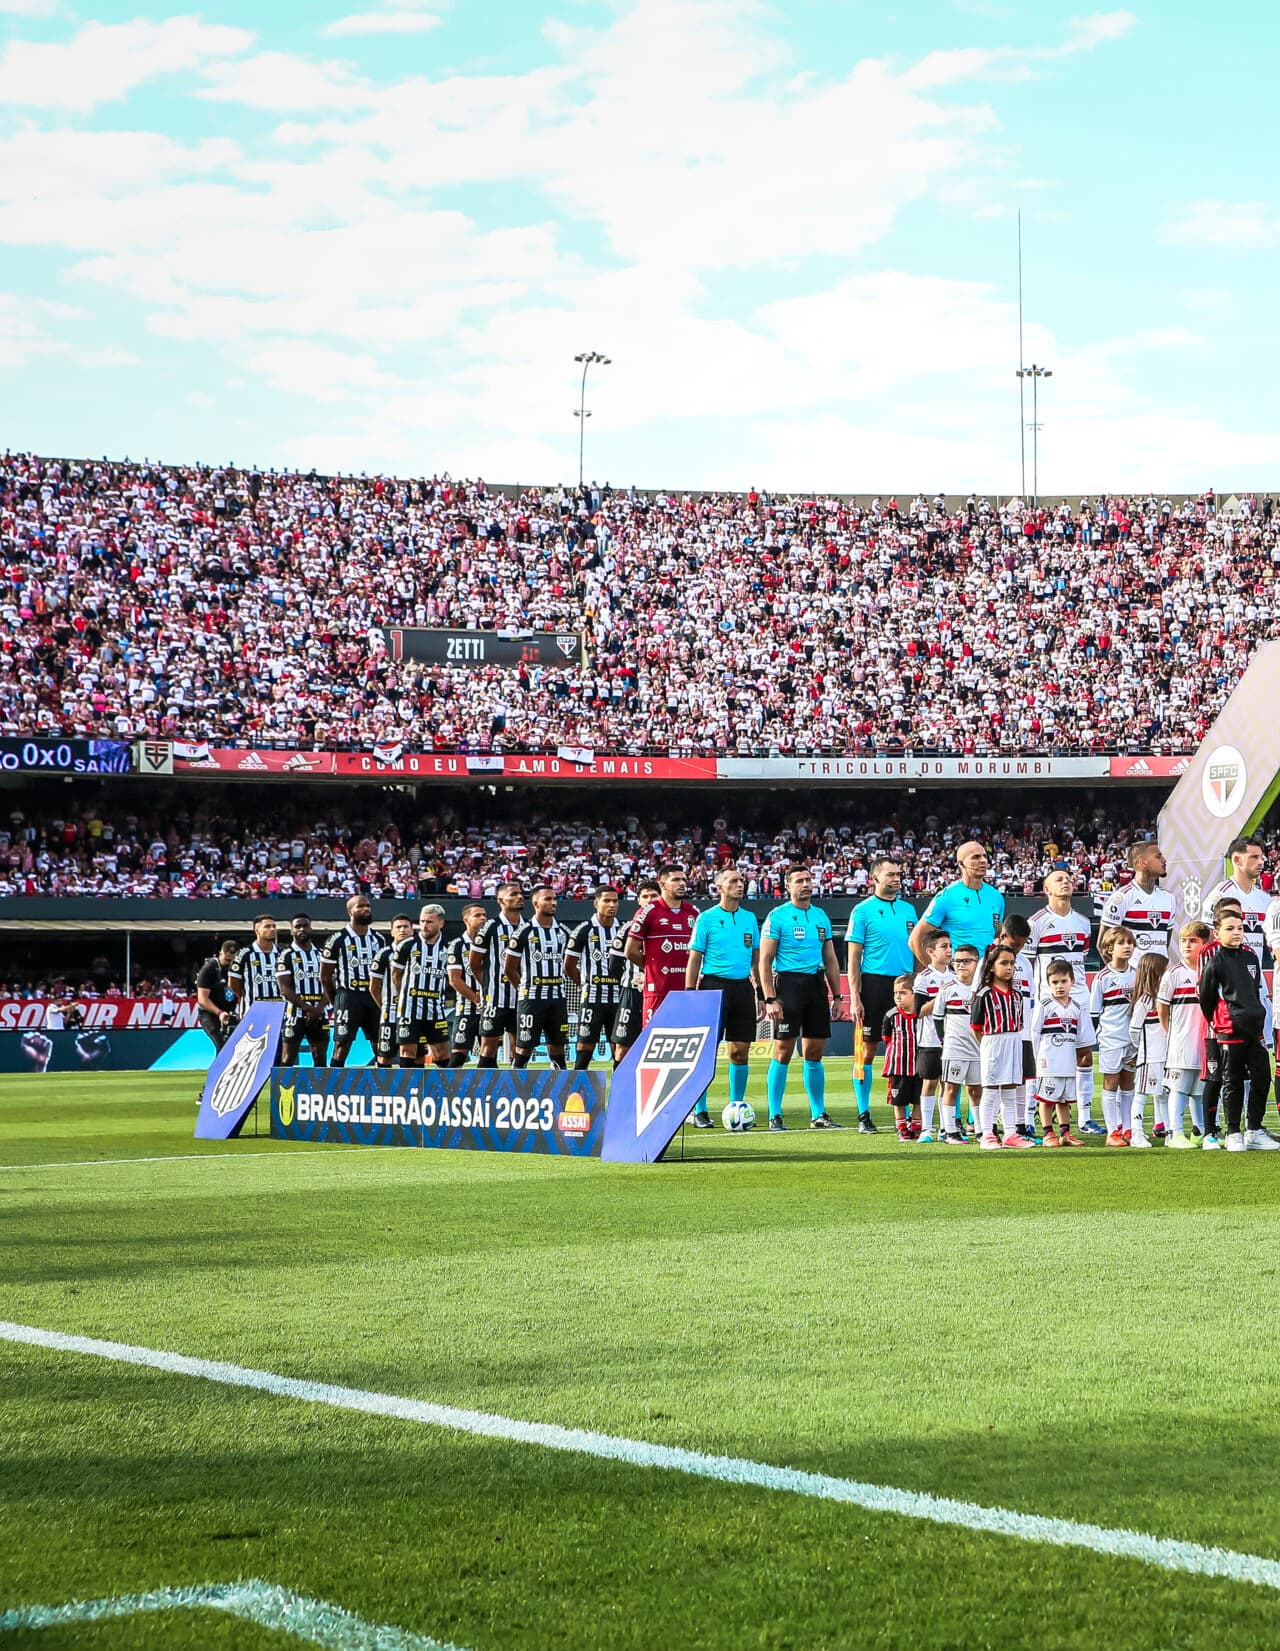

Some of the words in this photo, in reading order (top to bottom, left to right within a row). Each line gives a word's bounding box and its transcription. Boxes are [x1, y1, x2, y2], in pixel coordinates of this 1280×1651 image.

[390, 630, 403, 660] 1
[446, 638, 485, 660] ZETTI
[22, 742, 72, 767] 0x0
[434, 758, 458, 772] EU
[519, 759, 560, 773] AMO
[575, 761, 653, 775] DEMAIS
[809, 761, 908, 774] TRICOLOR
[921, 761, 943, 774] DO
[957, 761, 1053, 774] MORUMBI
[1210, 766, 1238, 778] SPFC
[336, 1009, 349, 1023] 24
[519, 1014, 534, 1029] 30
[580, 1008, 593, 1024] 13
[618, 1008, 631, 1024] 16
[646, 1008, 653, 1024] 3
[458, 1018, 468, 1031] 6
[380, 1026, 392, 1040] 19
[646, 1037, 700, 1060] SPFC
[296, 1087, 437, 1127] BRASILEIRÃO
[438, 1094, 491, 1128] ASSAÍ
[495, 1096, 555, 1132] 2023
